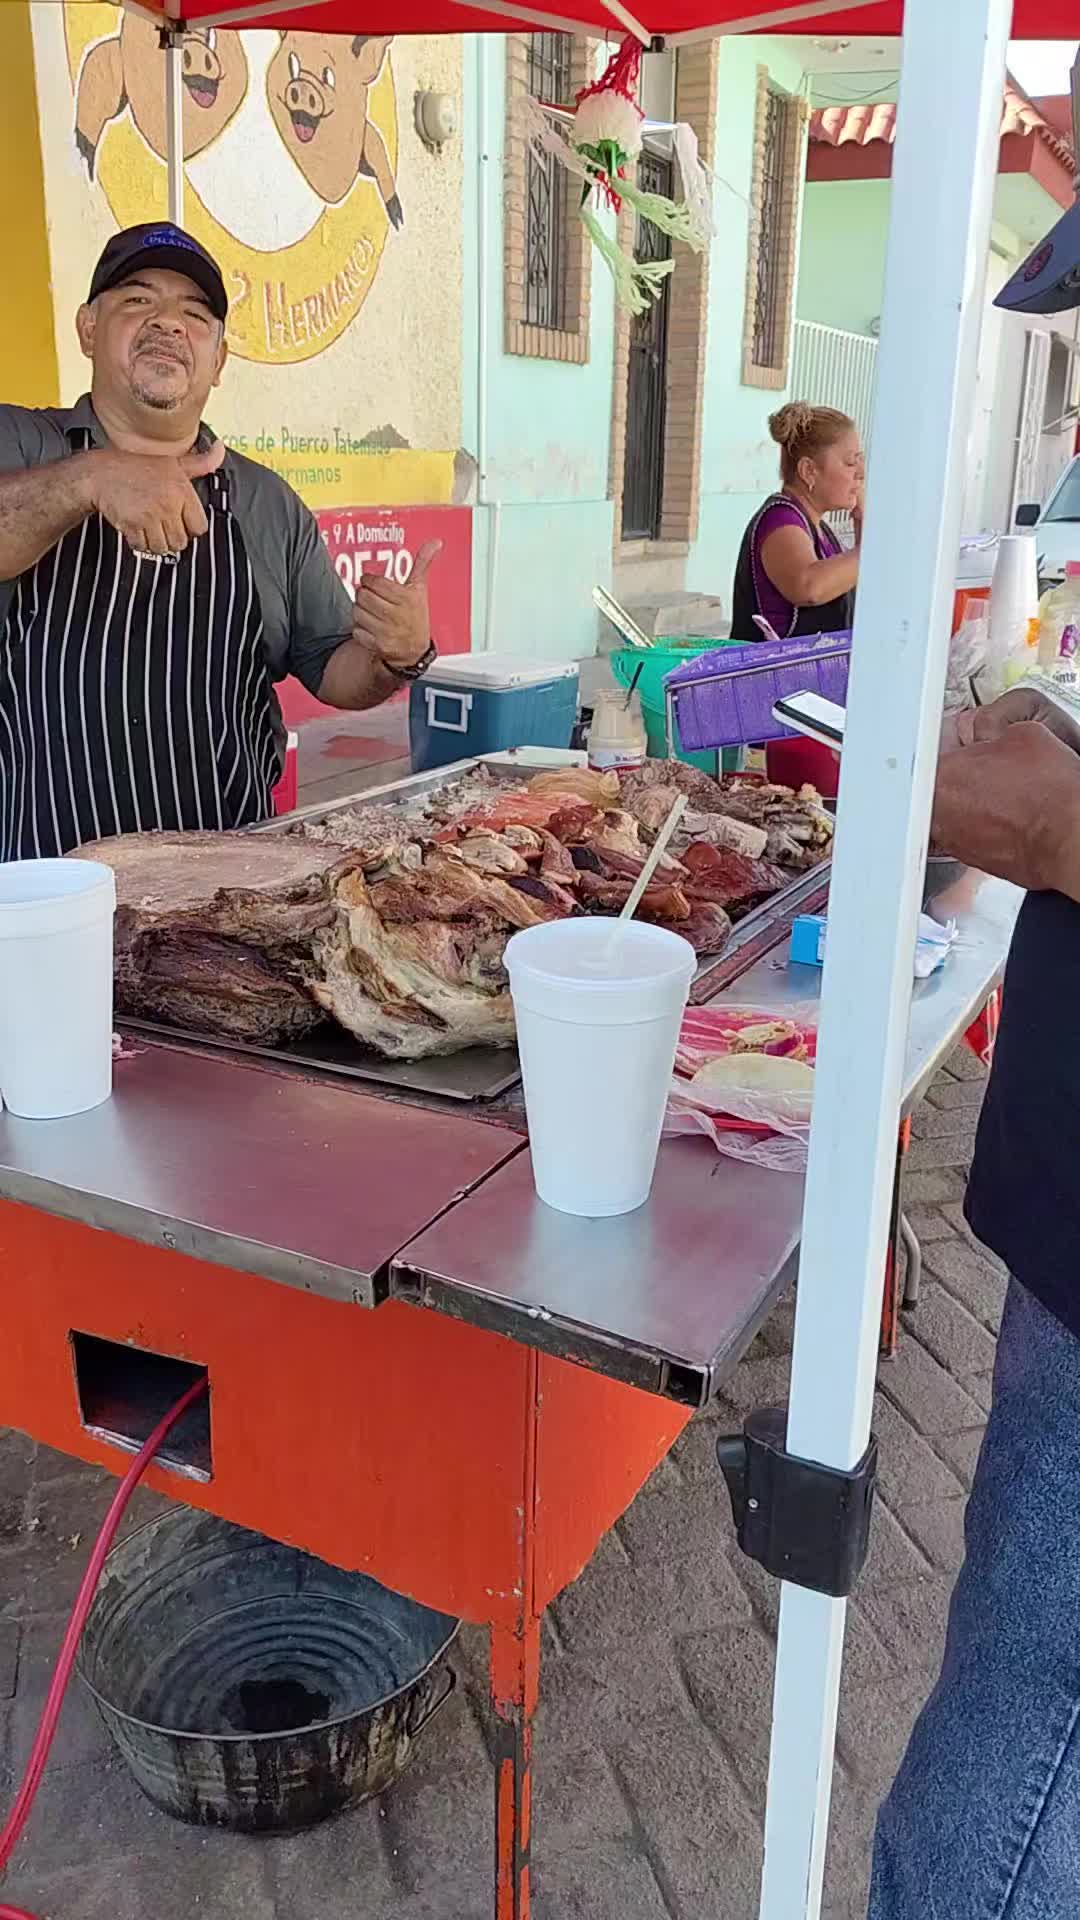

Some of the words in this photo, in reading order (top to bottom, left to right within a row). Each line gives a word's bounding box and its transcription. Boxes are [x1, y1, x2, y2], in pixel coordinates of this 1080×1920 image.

[255, 427, 275, 453] de
[281, 426, 329, 455] Puerco
[266, 461, 342, 486] ermanos
[345, 522, 356, 545] A
